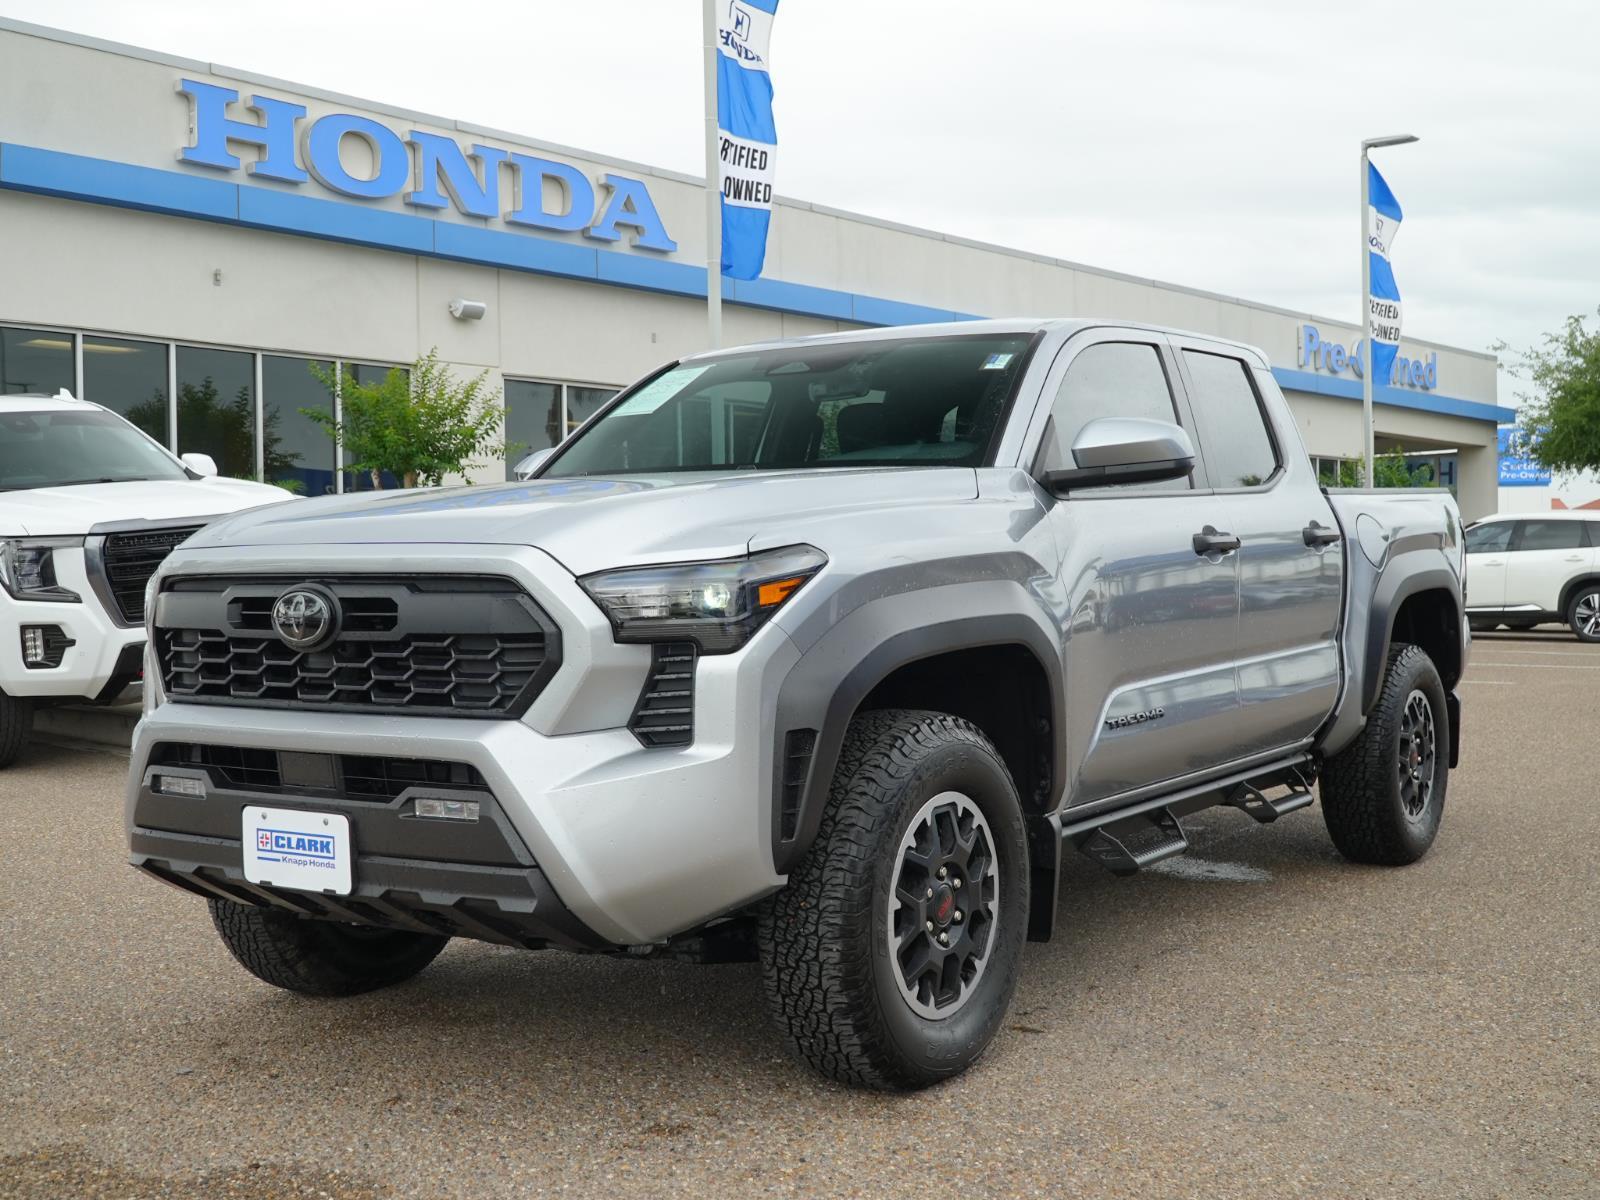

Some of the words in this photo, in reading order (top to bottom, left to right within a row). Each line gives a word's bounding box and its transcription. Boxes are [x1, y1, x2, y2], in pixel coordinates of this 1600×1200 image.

[175, 78, 677, 252] HONDA
[1298, 323, 1437, 390] Pre-ned
[1105, 707, 1165, 730] TACOMA
[274, 835, 332, 854] CLARK
[281, 856, 308, 867] Knapp
[309, 858, 336, 869] Honda
